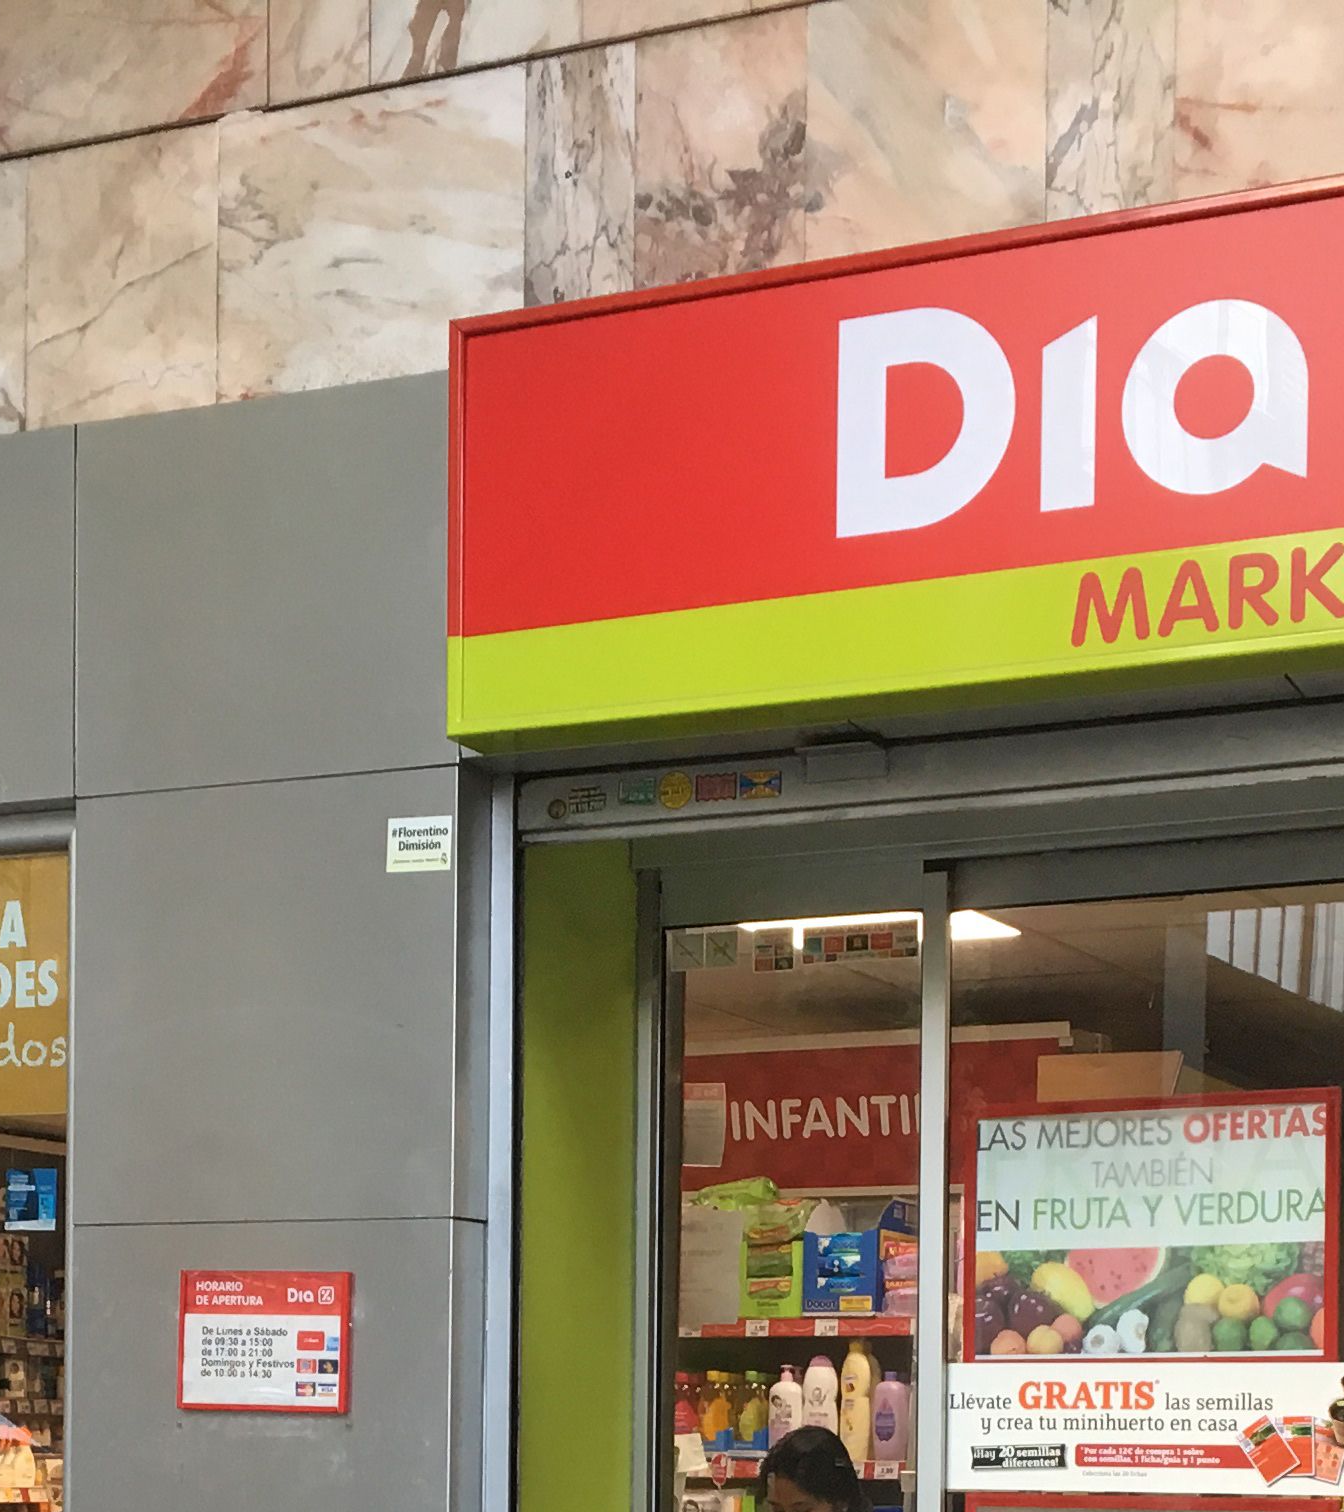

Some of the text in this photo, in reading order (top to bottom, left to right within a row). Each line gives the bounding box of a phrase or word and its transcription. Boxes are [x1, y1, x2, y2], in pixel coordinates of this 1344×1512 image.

[398, 839, 441, 851] Dimisión
[977, 1105, 1327, 1151] LAS MEJORES OFERTAS
[1091, 1151, 1213, 1189] TAMBIÉN
[977, 1187, 1325, 1232] EN FRUTA Y VERDURA
[196, 1281, 243, 1291] HORARIO
[196, 1295, 263, 1306] DE APERTURA
[201, 1358, 246, 1369] Domingos
[256, 1359, 295, 1369] Festivos
[949, 1393, 1012, 1411] Llévate
[1165, 1392, 1191, 1411] las
[1196, 1392, 1274, 1412] semillas
[981, 1413, 1239, 1435] y crea tu minihuerto en casa
[999, 1446, 1015, 1458] 20
[1016, 1445, 1061, 1457] semillas
[1002, 1457, 1059, 1468] diferentes!
